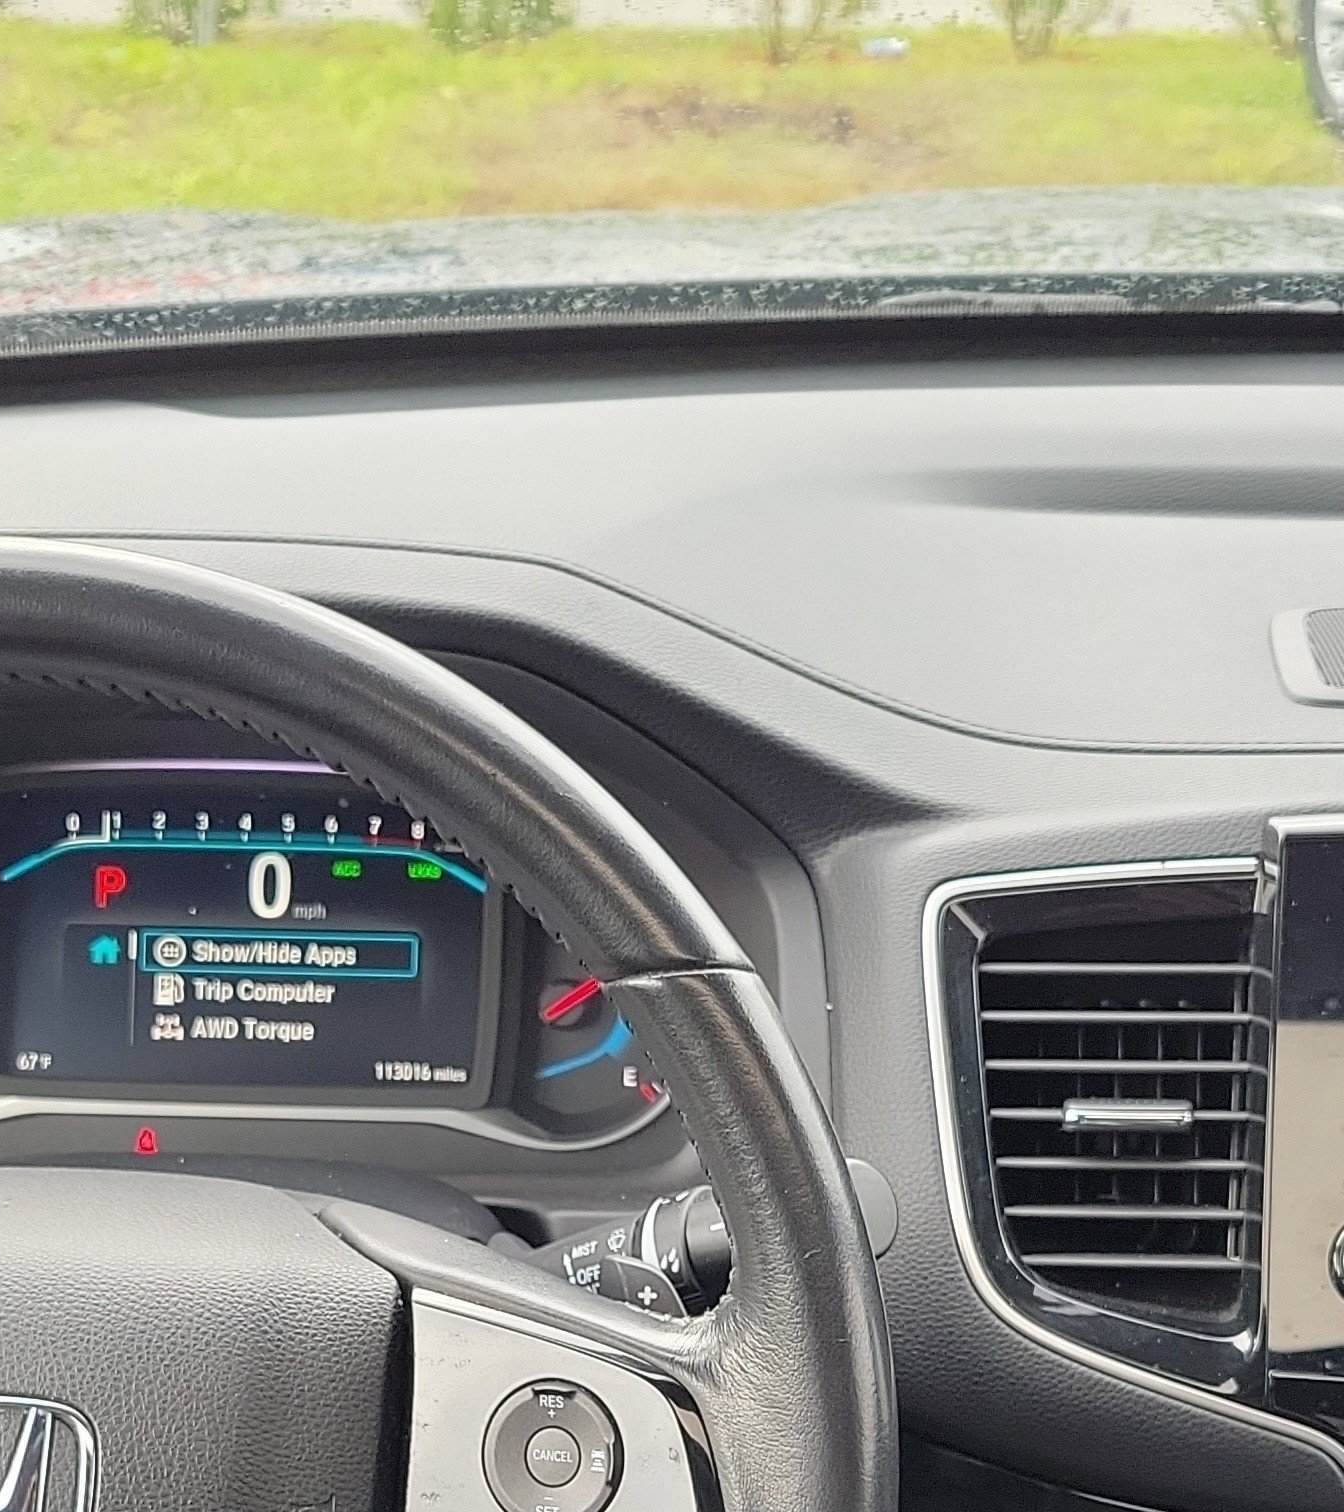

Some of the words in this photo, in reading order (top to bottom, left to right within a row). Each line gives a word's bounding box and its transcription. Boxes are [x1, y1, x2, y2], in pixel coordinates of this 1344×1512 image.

[152, 811, 166, 830] 2
[195, 811, 209, 830] 3
[238, 812, 252, 831] 4
[281, 812, 295, 832] 5
[324, 814, 338, 833] 6
[368, 815, 382, 835] 7
[95, 866, 126, 907] P
[248, 851, 291, 919] 0
[292, 902, 327, 920] mph
[192, 939, 302, 964] Show/Hide
[304, 942, 357, 967] Apps
[192, 977, 234, 1003] Trip
[236, 979, 336, 1004] Computer
[190, 1015, 239, 1040] AWD
[241, 1016, 315, 1043] Torque
[374, 1061, 431, 1082] 113016
[432, 1066, 467, 1082] miles
[623, 1066, 638, 1087] E
[576, 1263, 601, 1285] OFF
[538, 1394, 564, 1409] RES
[532, 1449, 573, 1464] CANCEL
